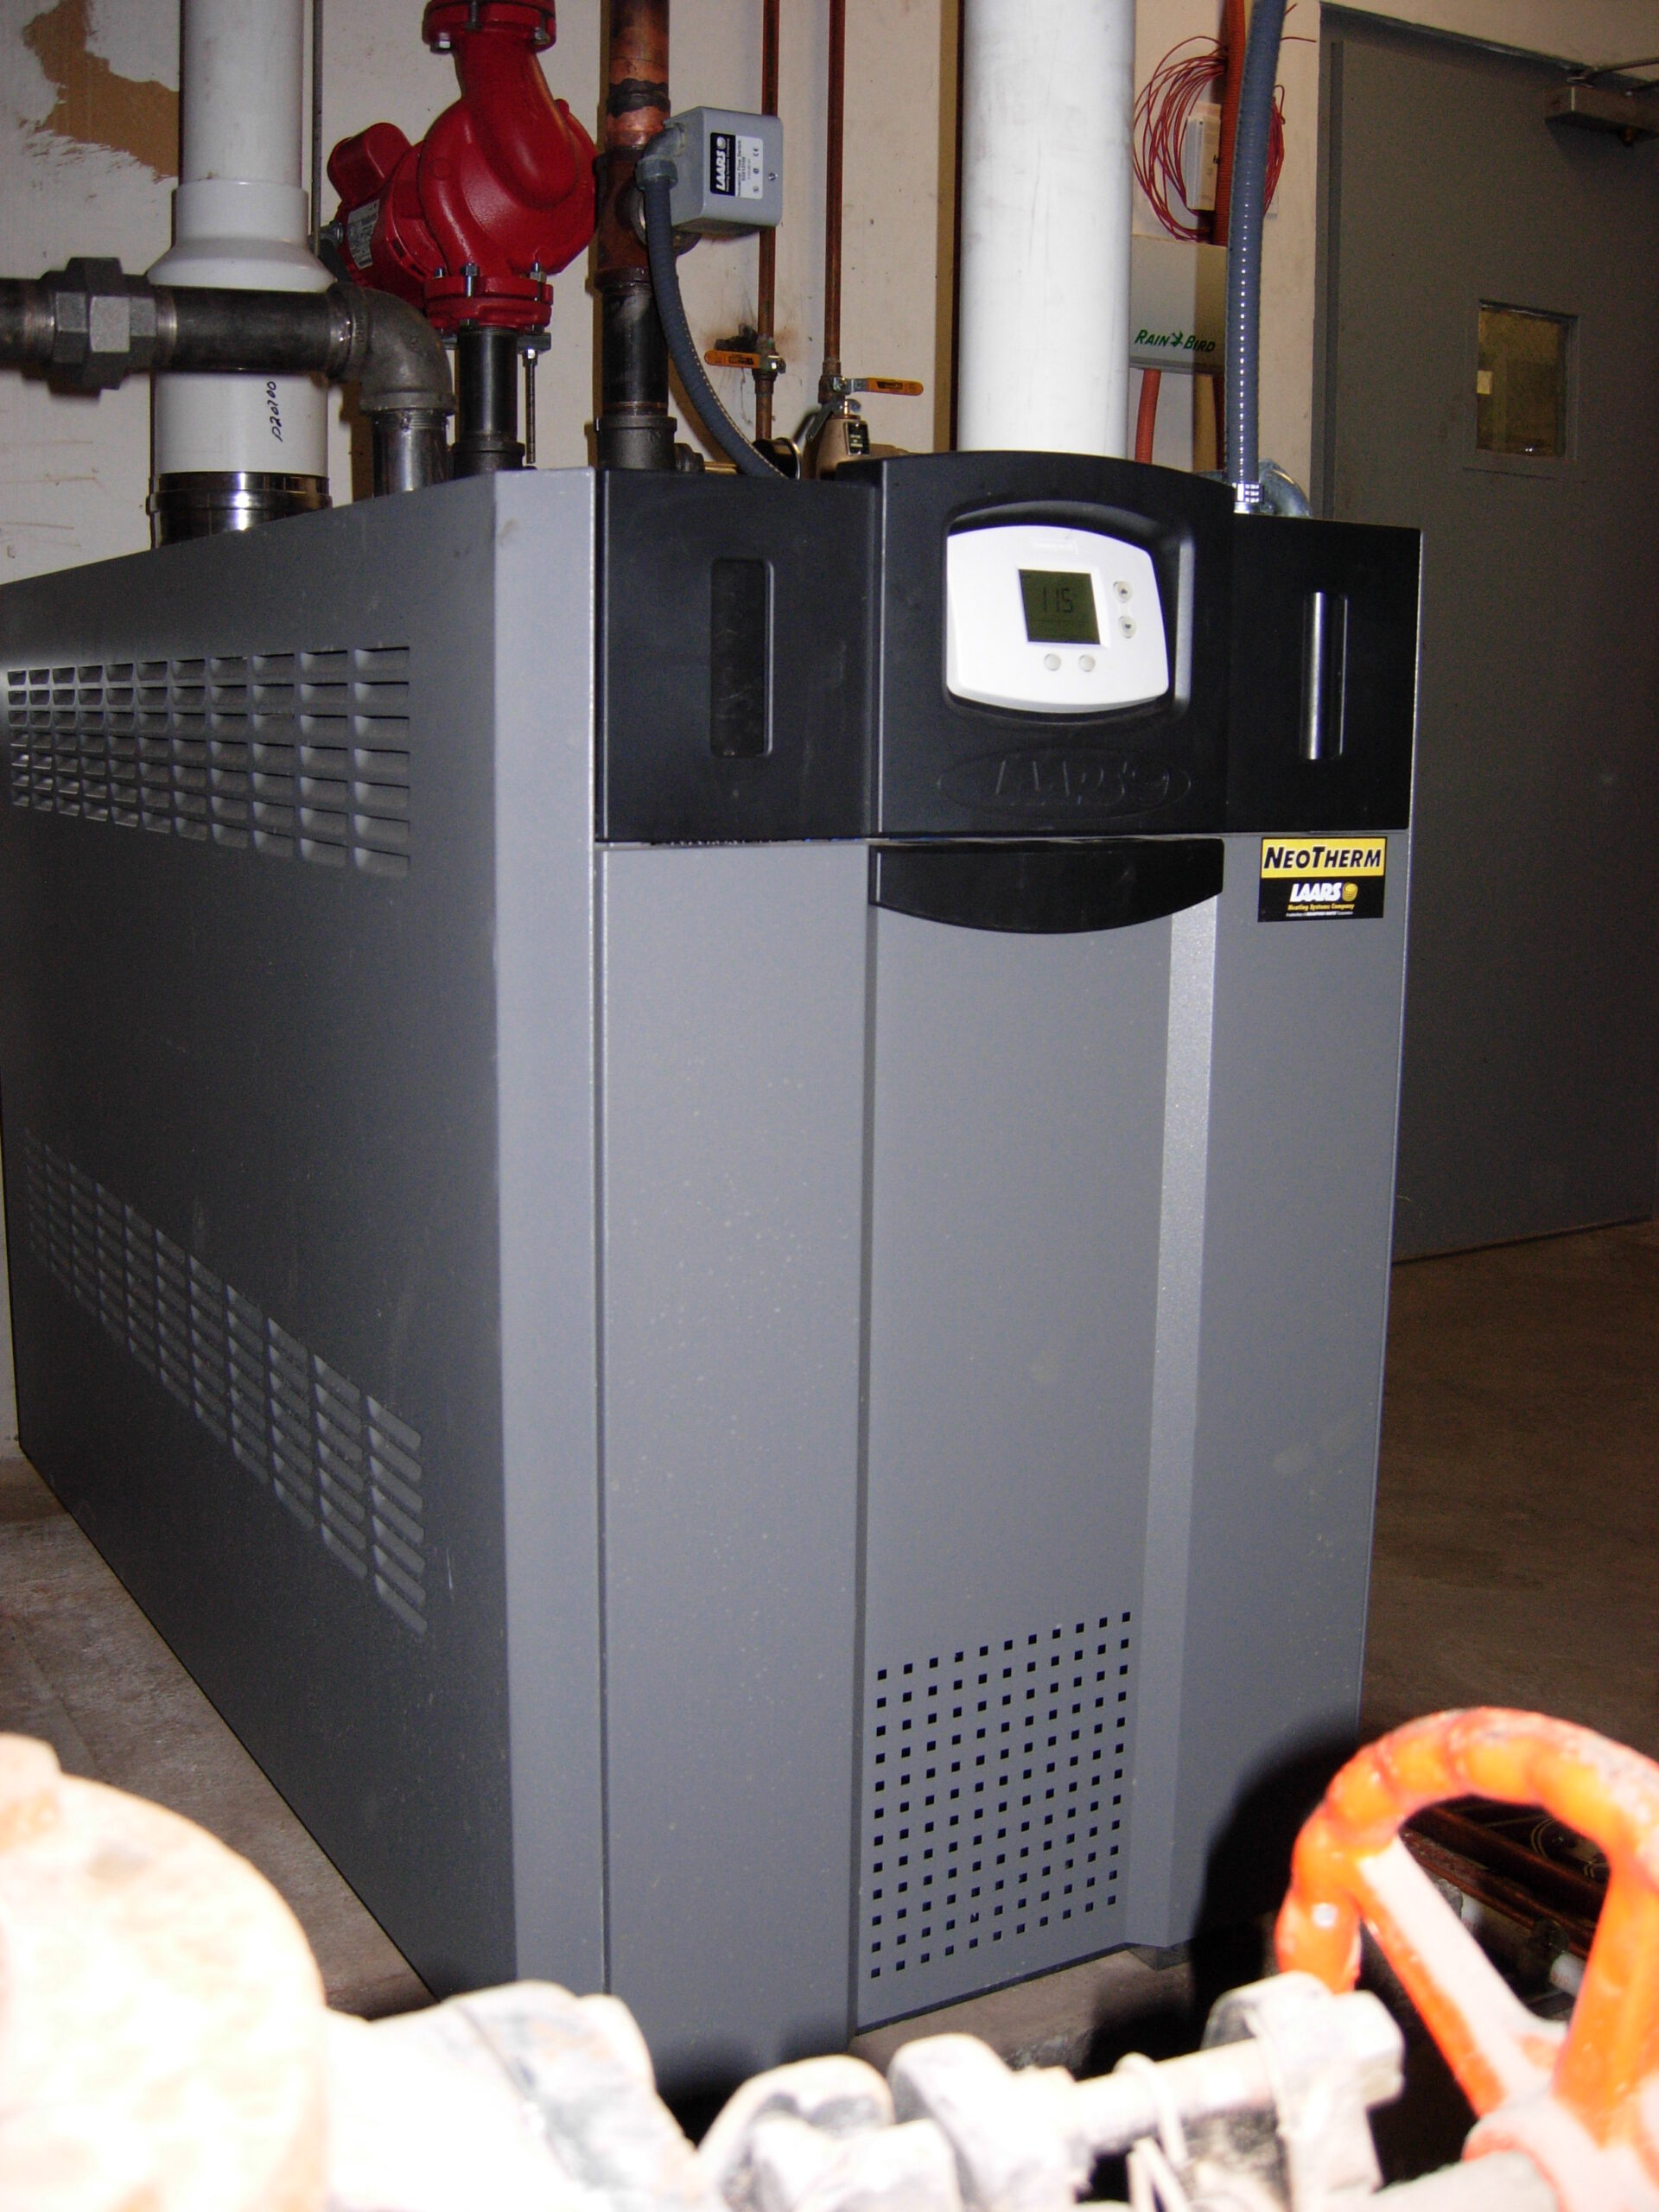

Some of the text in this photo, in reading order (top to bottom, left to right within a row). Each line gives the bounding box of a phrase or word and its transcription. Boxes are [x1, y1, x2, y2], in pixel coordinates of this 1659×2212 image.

[715, 149, 726, 191] LAARS
[1043, 587, 1073, 613] 115
[1289, 882, 1343, 902] LAARS
